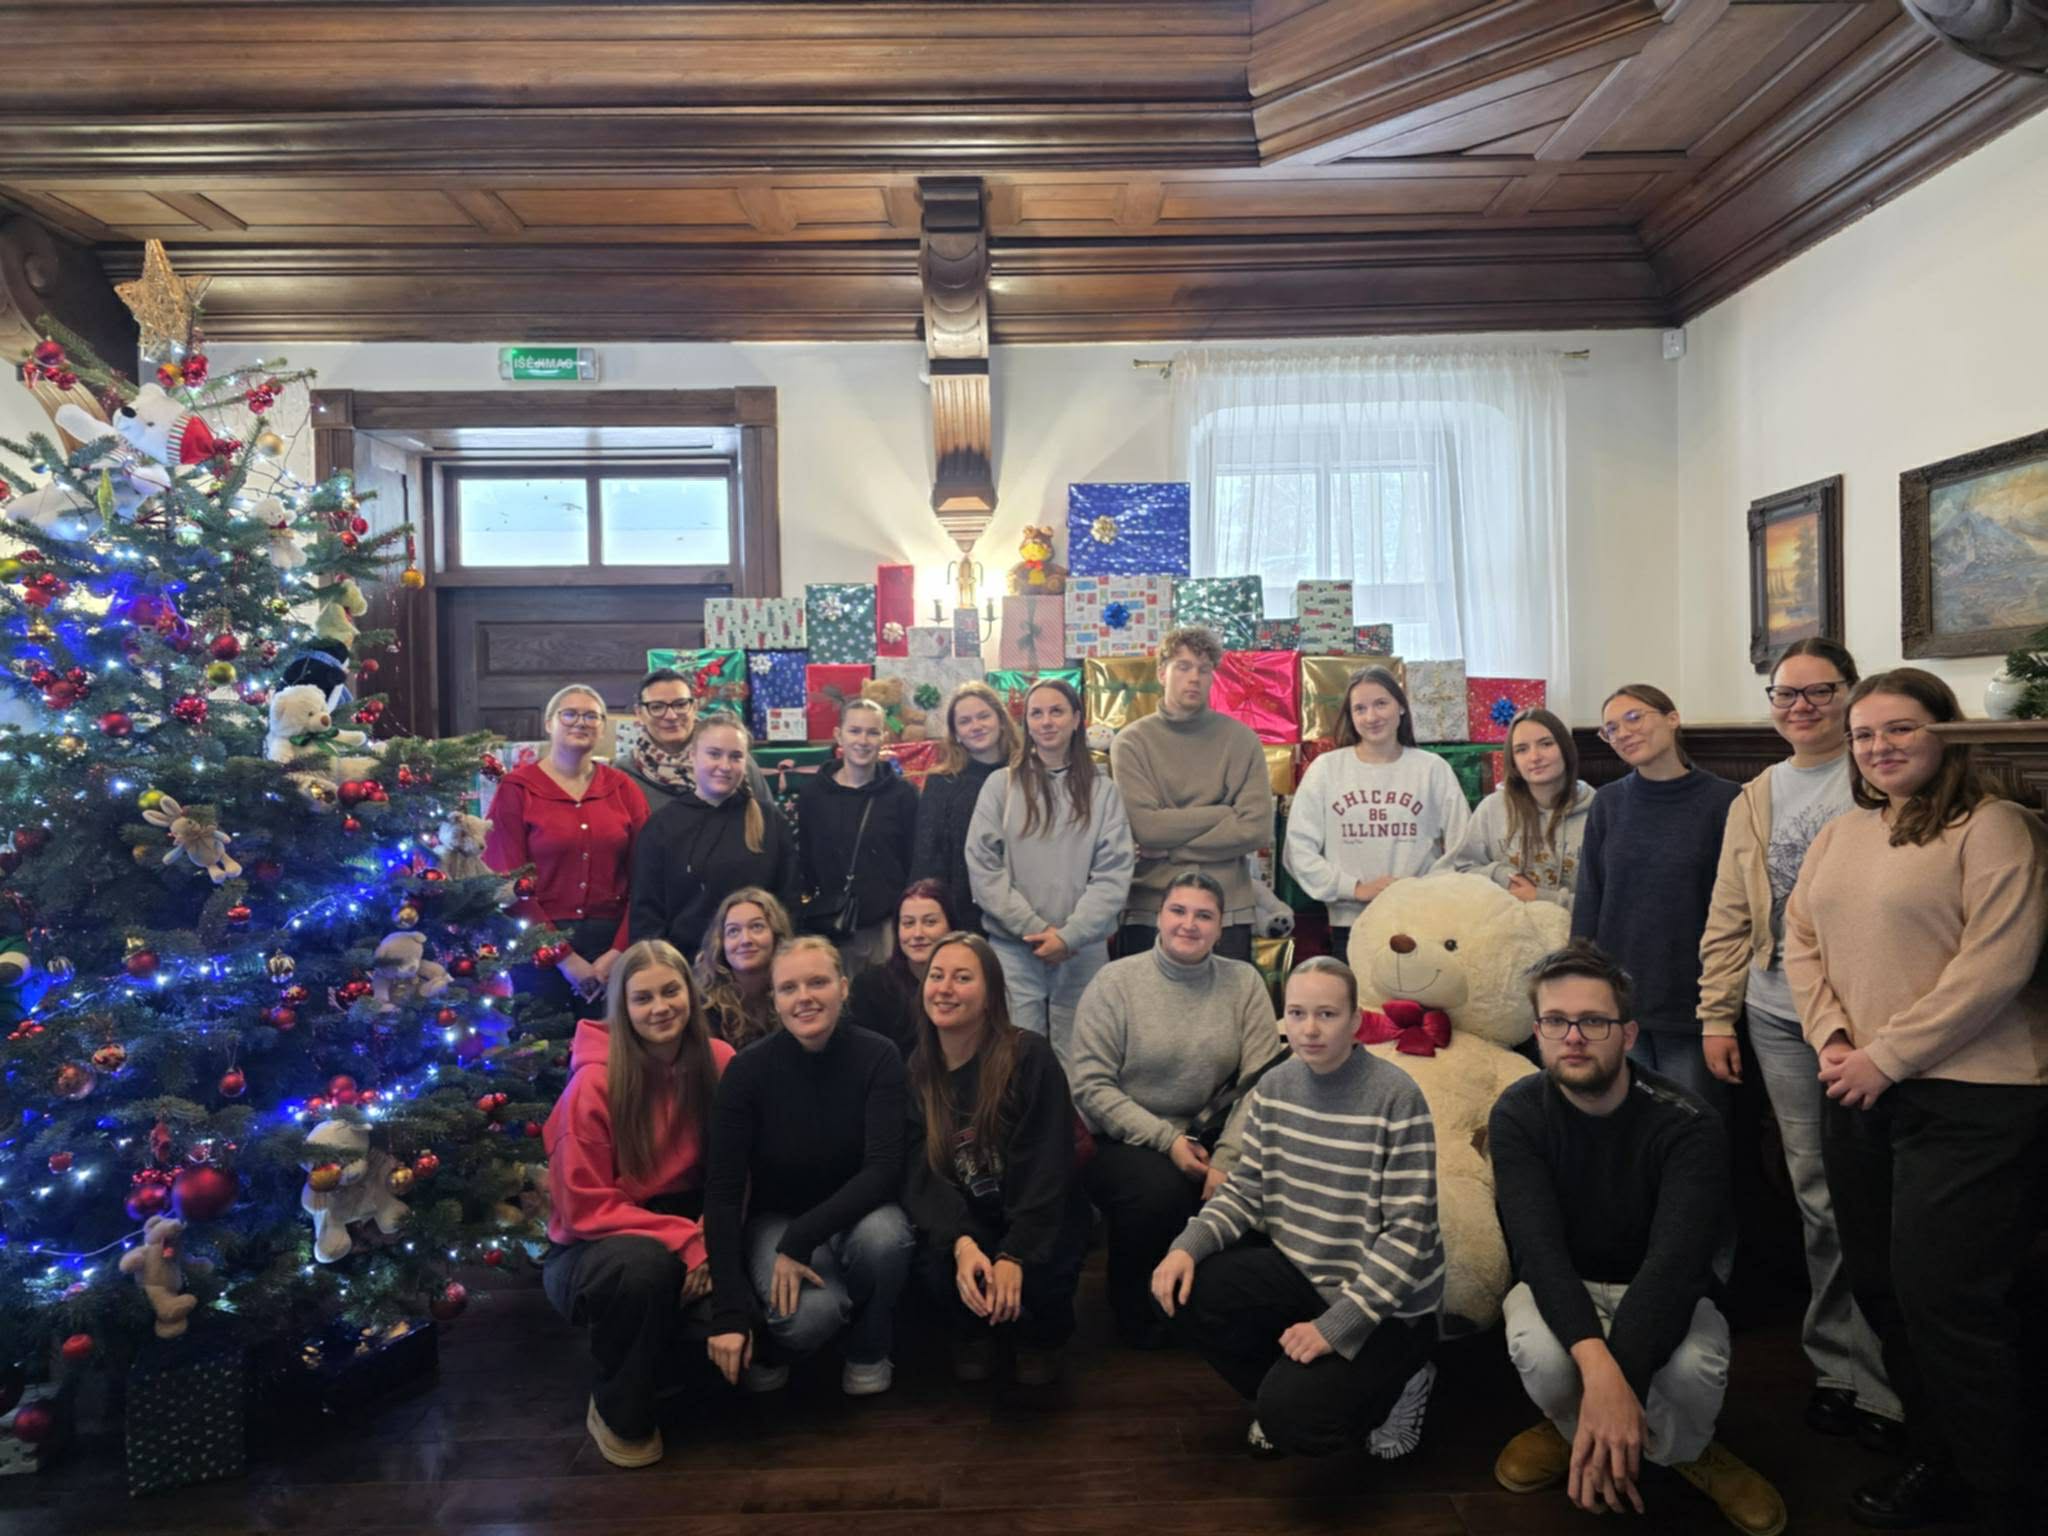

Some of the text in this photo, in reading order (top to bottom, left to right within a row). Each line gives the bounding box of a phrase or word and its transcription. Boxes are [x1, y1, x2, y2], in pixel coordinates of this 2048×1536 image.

[1332, 790, 1423, 817] CHICAGO
[1368, 808, 1387, 821] 86
[1341, 822, 1417, 838] ILLINOIS
